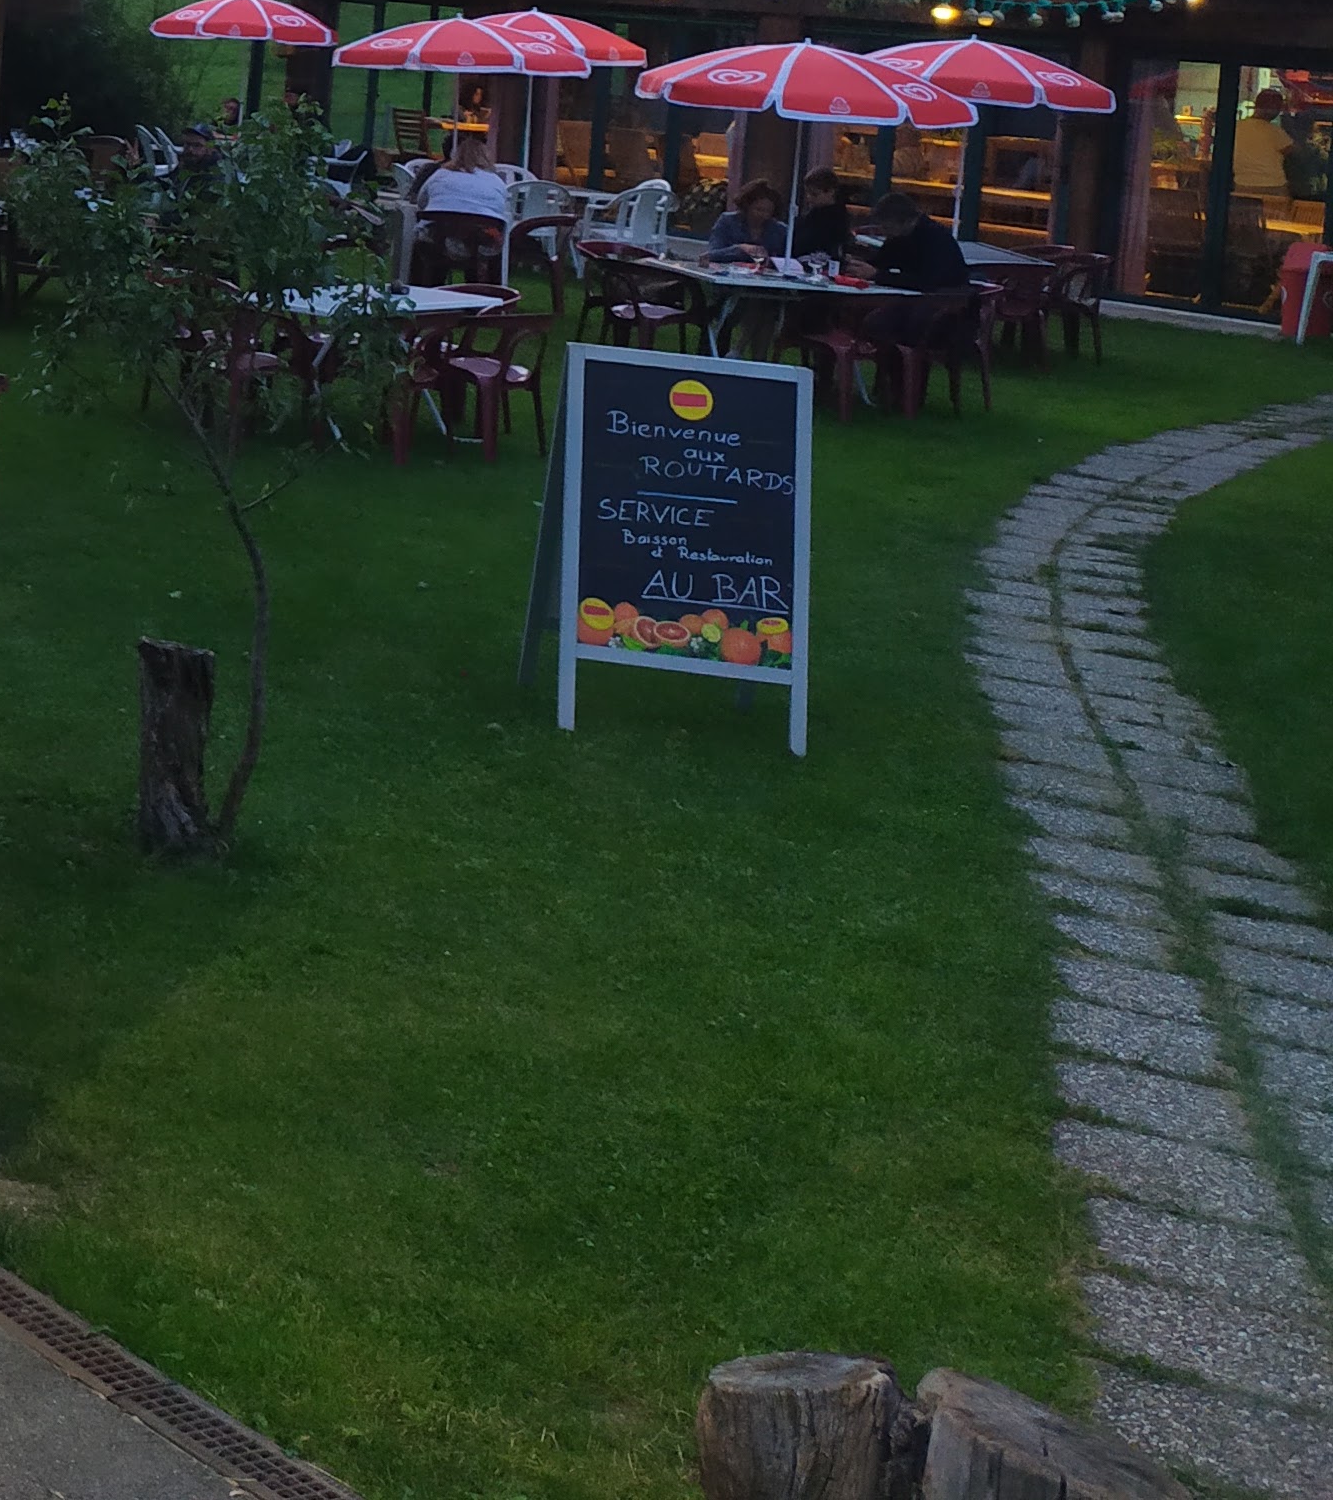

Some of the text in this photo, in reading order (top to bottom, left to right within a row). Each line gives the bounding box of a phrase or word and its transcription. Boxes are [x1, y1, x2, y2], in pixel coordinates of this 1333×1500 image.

[606, 409, 741, 447] Bienvenue
[683, 447, 726, 463] aux
[638, 456, 794, 495] ROUTARDS
[597, 498, 715, 527] SERVICE
[677, 546, 773, 567] Restauration
[642, 569, 789, 610] AU BAR
